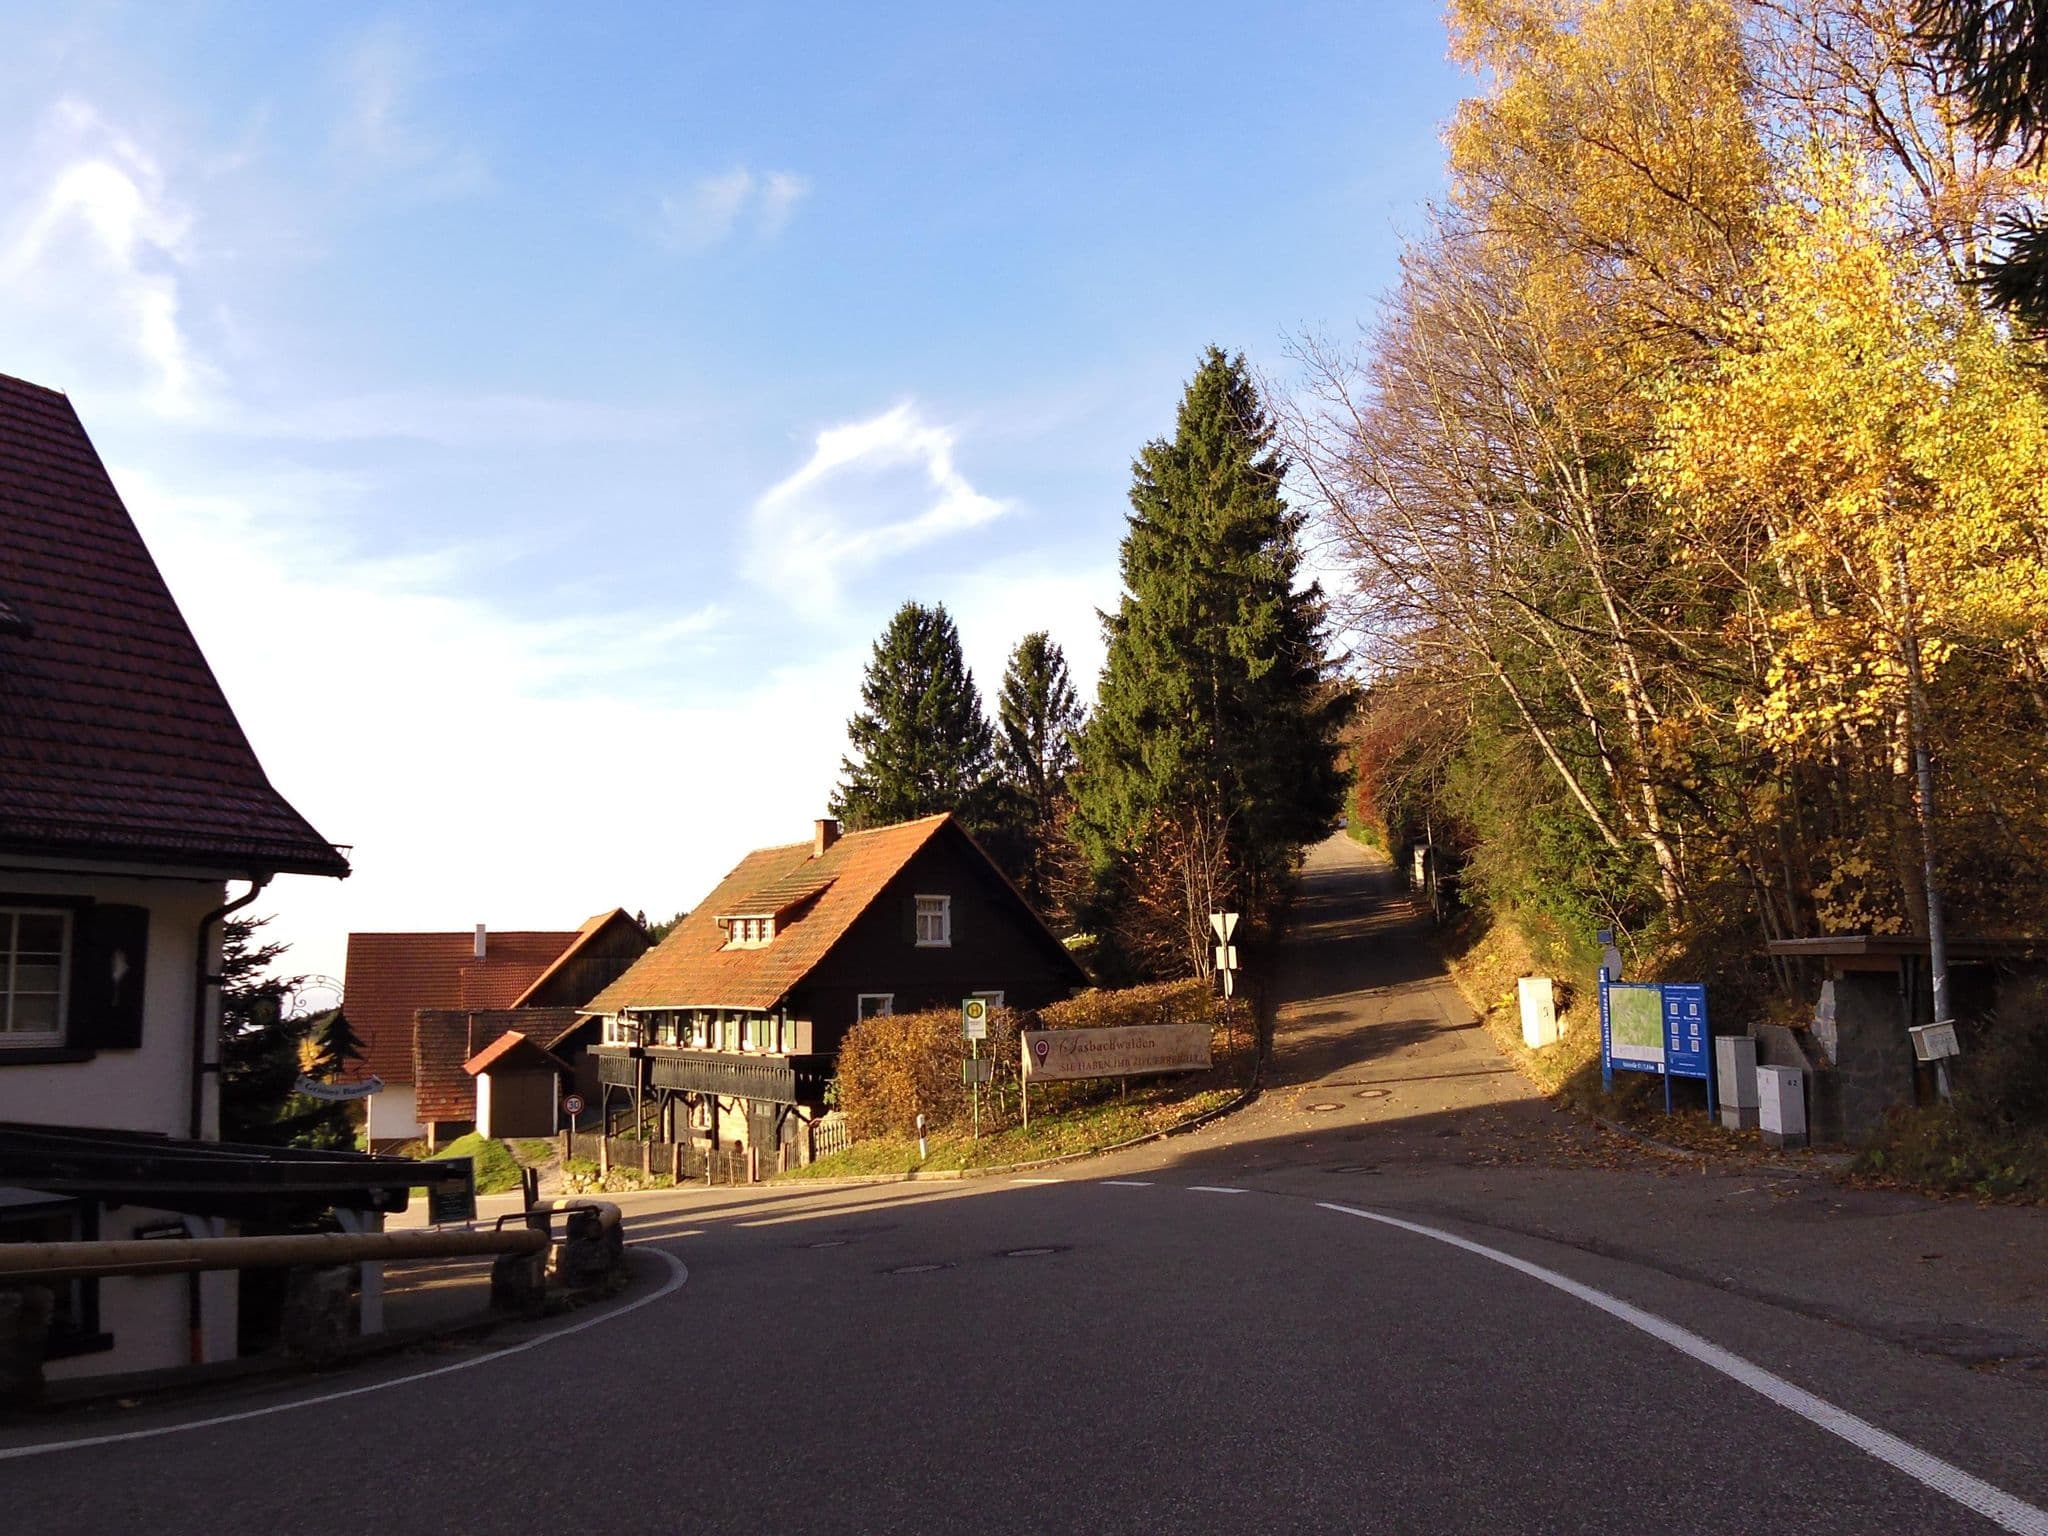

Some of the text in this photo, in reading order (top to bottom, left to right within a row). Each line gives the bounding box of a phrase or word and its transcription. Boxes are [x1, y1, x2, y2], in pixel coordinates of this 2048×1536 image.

[1058, 1035, 1155, 1056] Sasbachwalden
[1078, 1060, 1111, 1071] HABEN
[568, 1100, 579, 1109] 30
